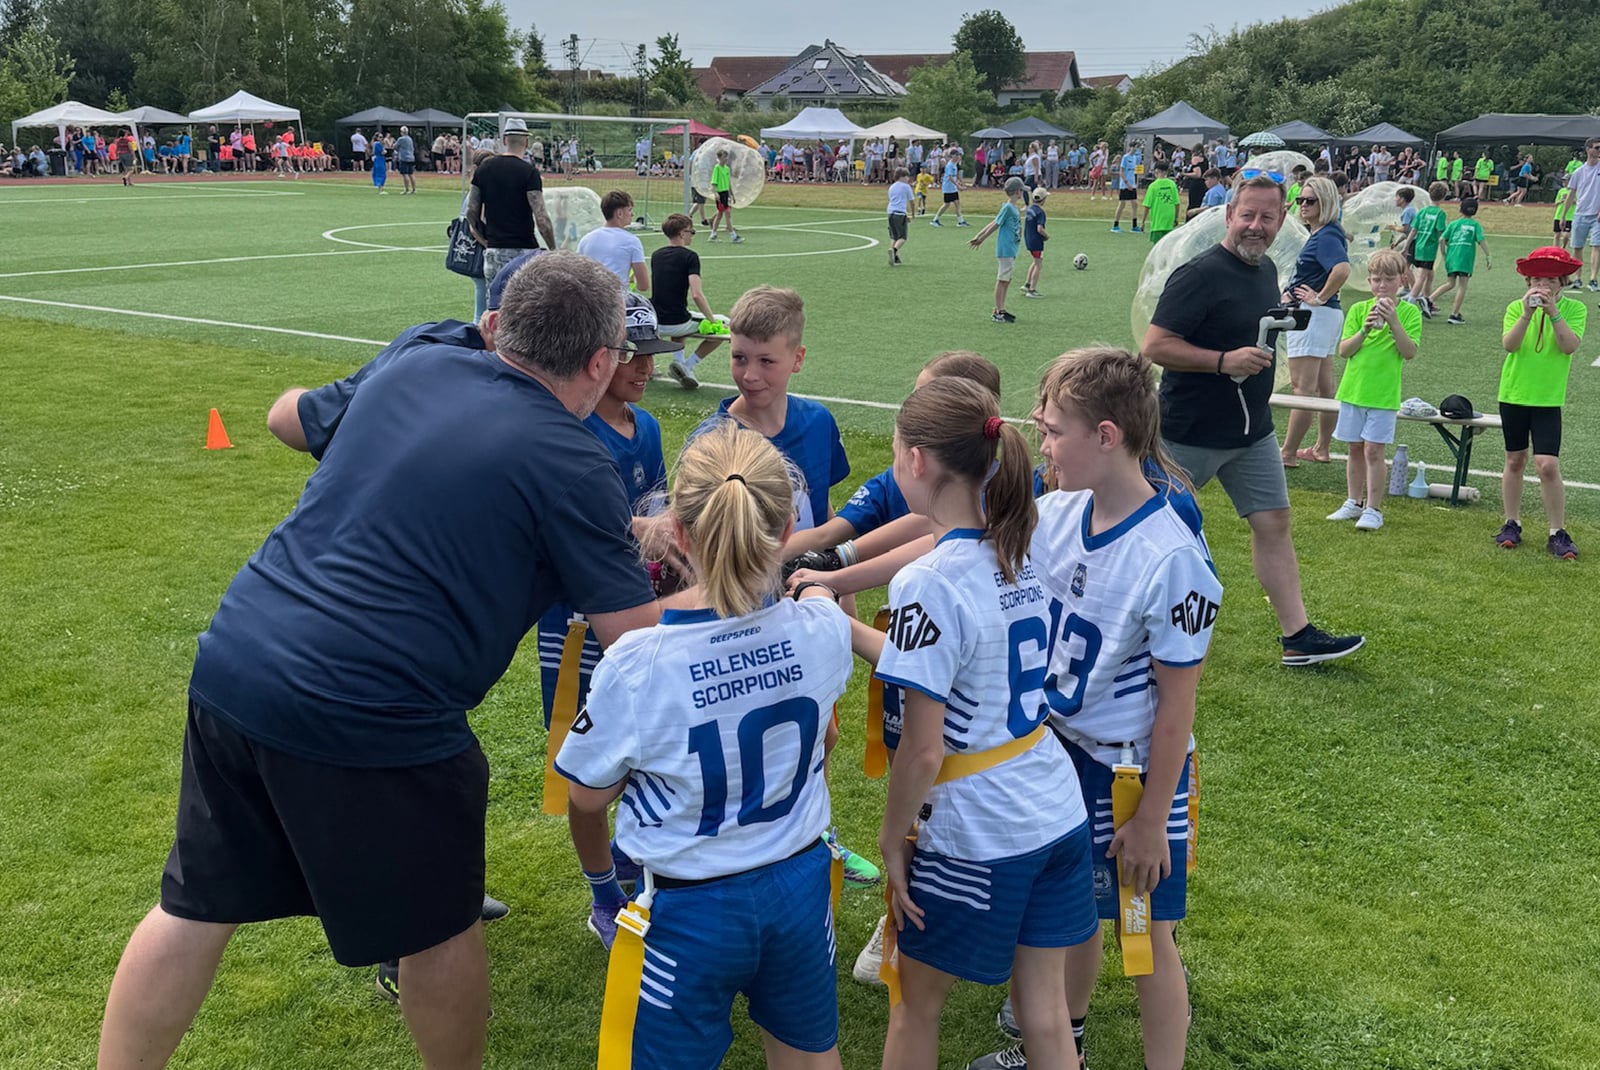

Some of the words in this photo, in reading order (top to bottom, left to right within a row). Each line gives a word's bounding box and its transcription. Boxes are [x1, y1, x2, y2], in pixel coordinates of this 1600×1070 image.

[999, 585, 1044, 611] SCORPIONS
[710, 626, 761, 644] DEEPSPEED
[689, 640, 795, 682] ERLENSEE
[1007, 616, 1050, 739] 6
[692, 664, 803, 709] SCORPIONS
[688, 697, 819, 836] 10
